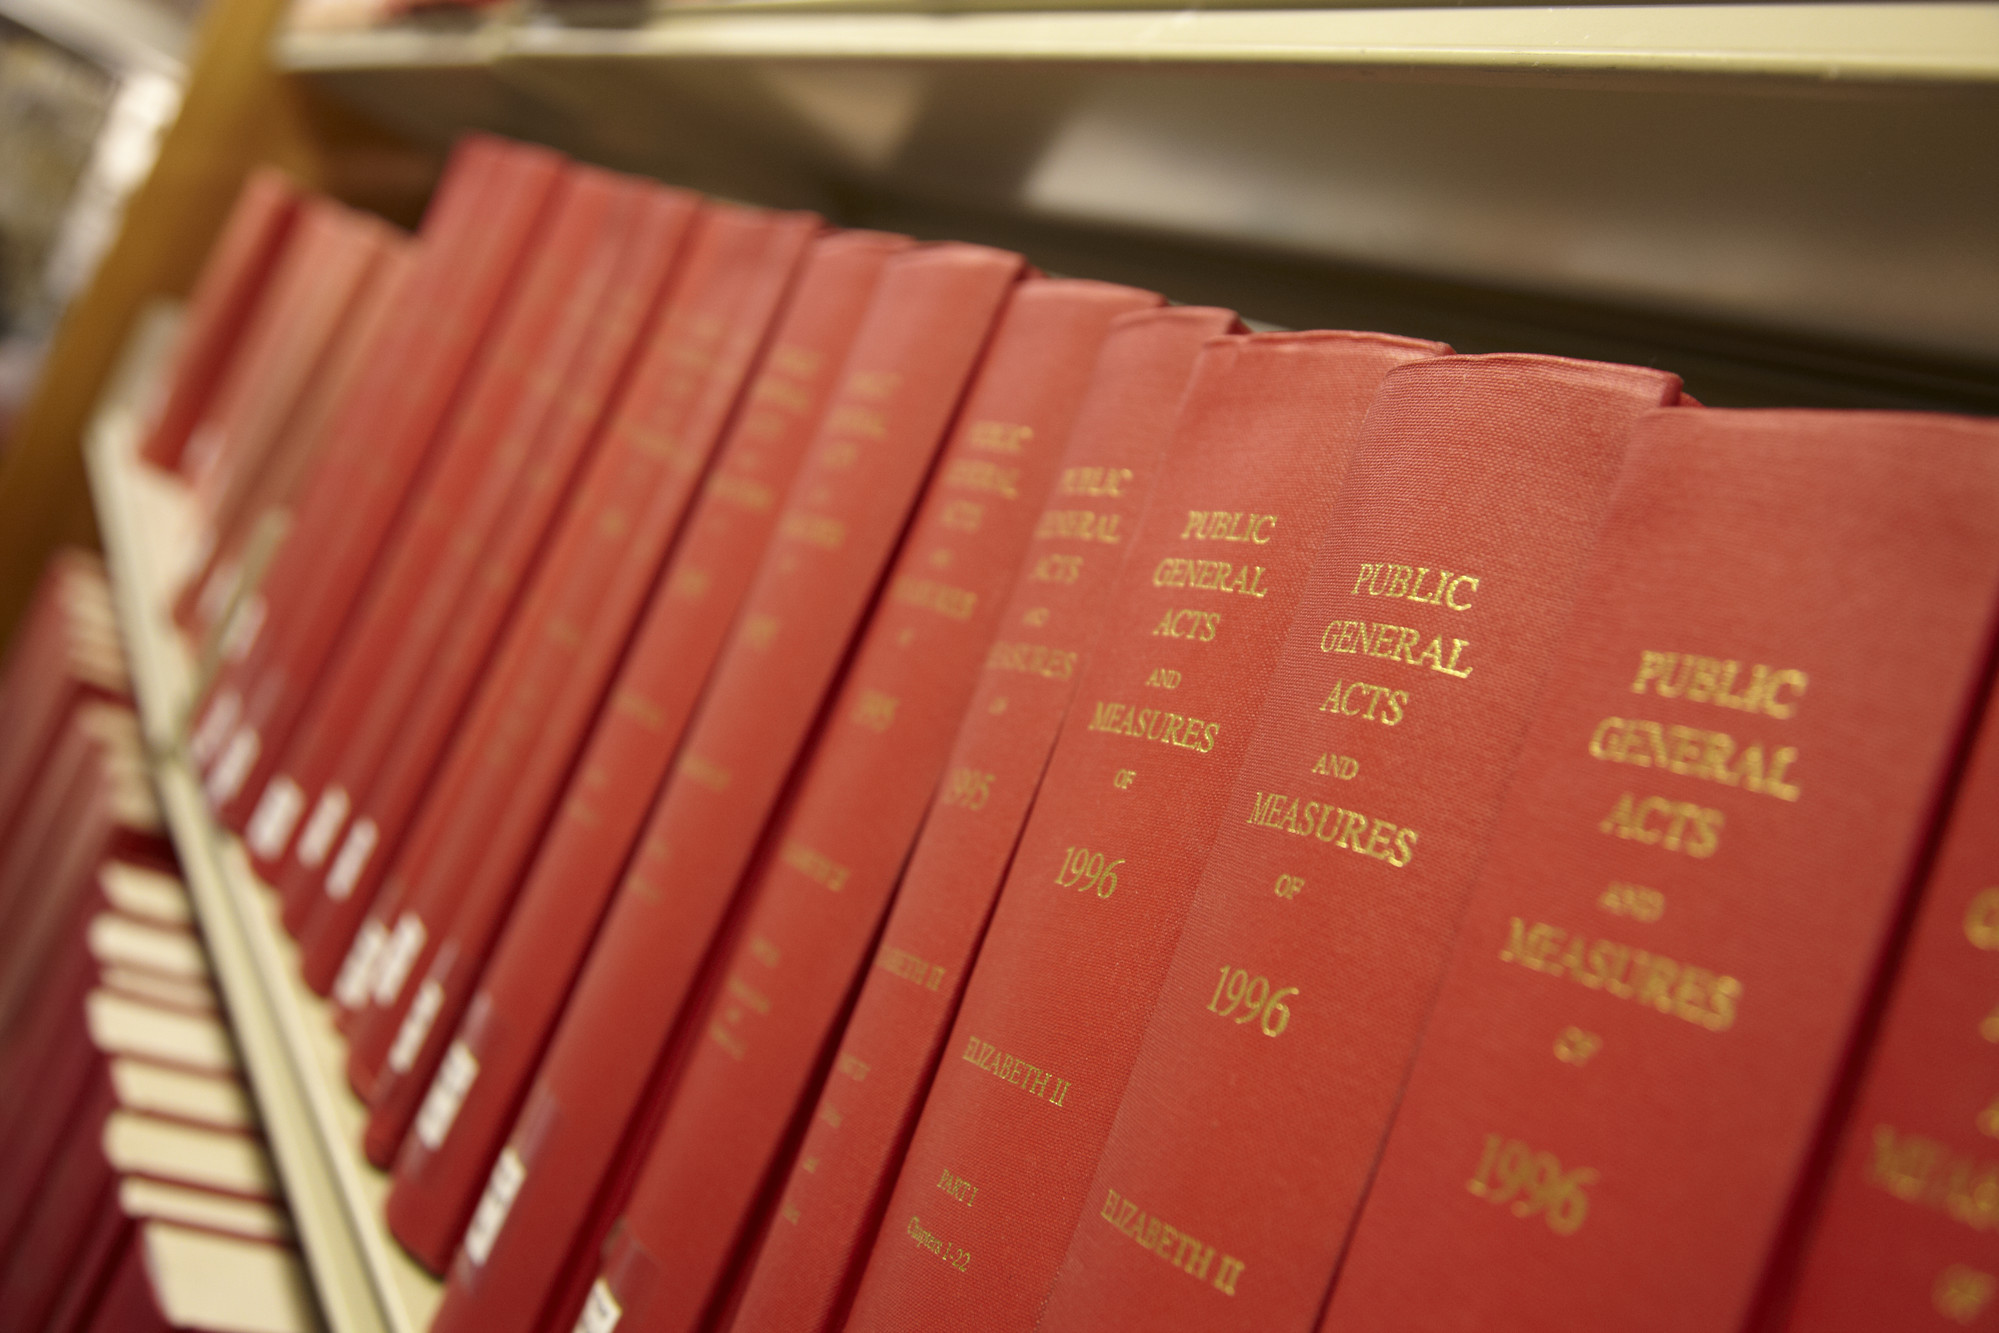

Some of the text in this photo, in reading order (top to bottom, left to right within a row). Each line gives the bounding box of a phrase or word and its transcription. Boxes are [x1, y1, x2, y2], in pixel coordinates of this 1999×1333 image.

[1181, 510, 1278, 544] PUBLIC
[1153, 558, 1268, 598] GENERAL
[1351, 562, 1479, 612] PUBLIC
[1153, 609, 1221, 642] ACTS
[1320, 619, 1473, 679] GENERAL
[1146, 668, 1181, 690] AND
[1319, 679, 1409, 726] ACTS
[1632, 649, 1808, 719] PUBLIC
[1088, 701, 1220, 753] MEASURES
[1114, 768, 1136, 789] OF
[1312, 753, 1359, 781] AND
[1589, 716, 1800, 802] GENERAL
[1246, 791, 1418, 868] MEASURES
[1600, 793, 1725, 859] ACTS
[1054, 846, 1125, 899] 1996
[1275, 873, 1304, 900] OF
[1498, 916, 1743, 1033] MEASURES
[1206, 965, 1300, 1037] 1996
[962, 1035, 1072, 1107] ELIZABETH II
[937, 1168, 979, 1207] PART I
[1466, 1132, 1600, 1236] 1996
[907, 1215, 943, 1255] Chapters
[1100, 1188, 1245, 1297] ELIZABETH II
